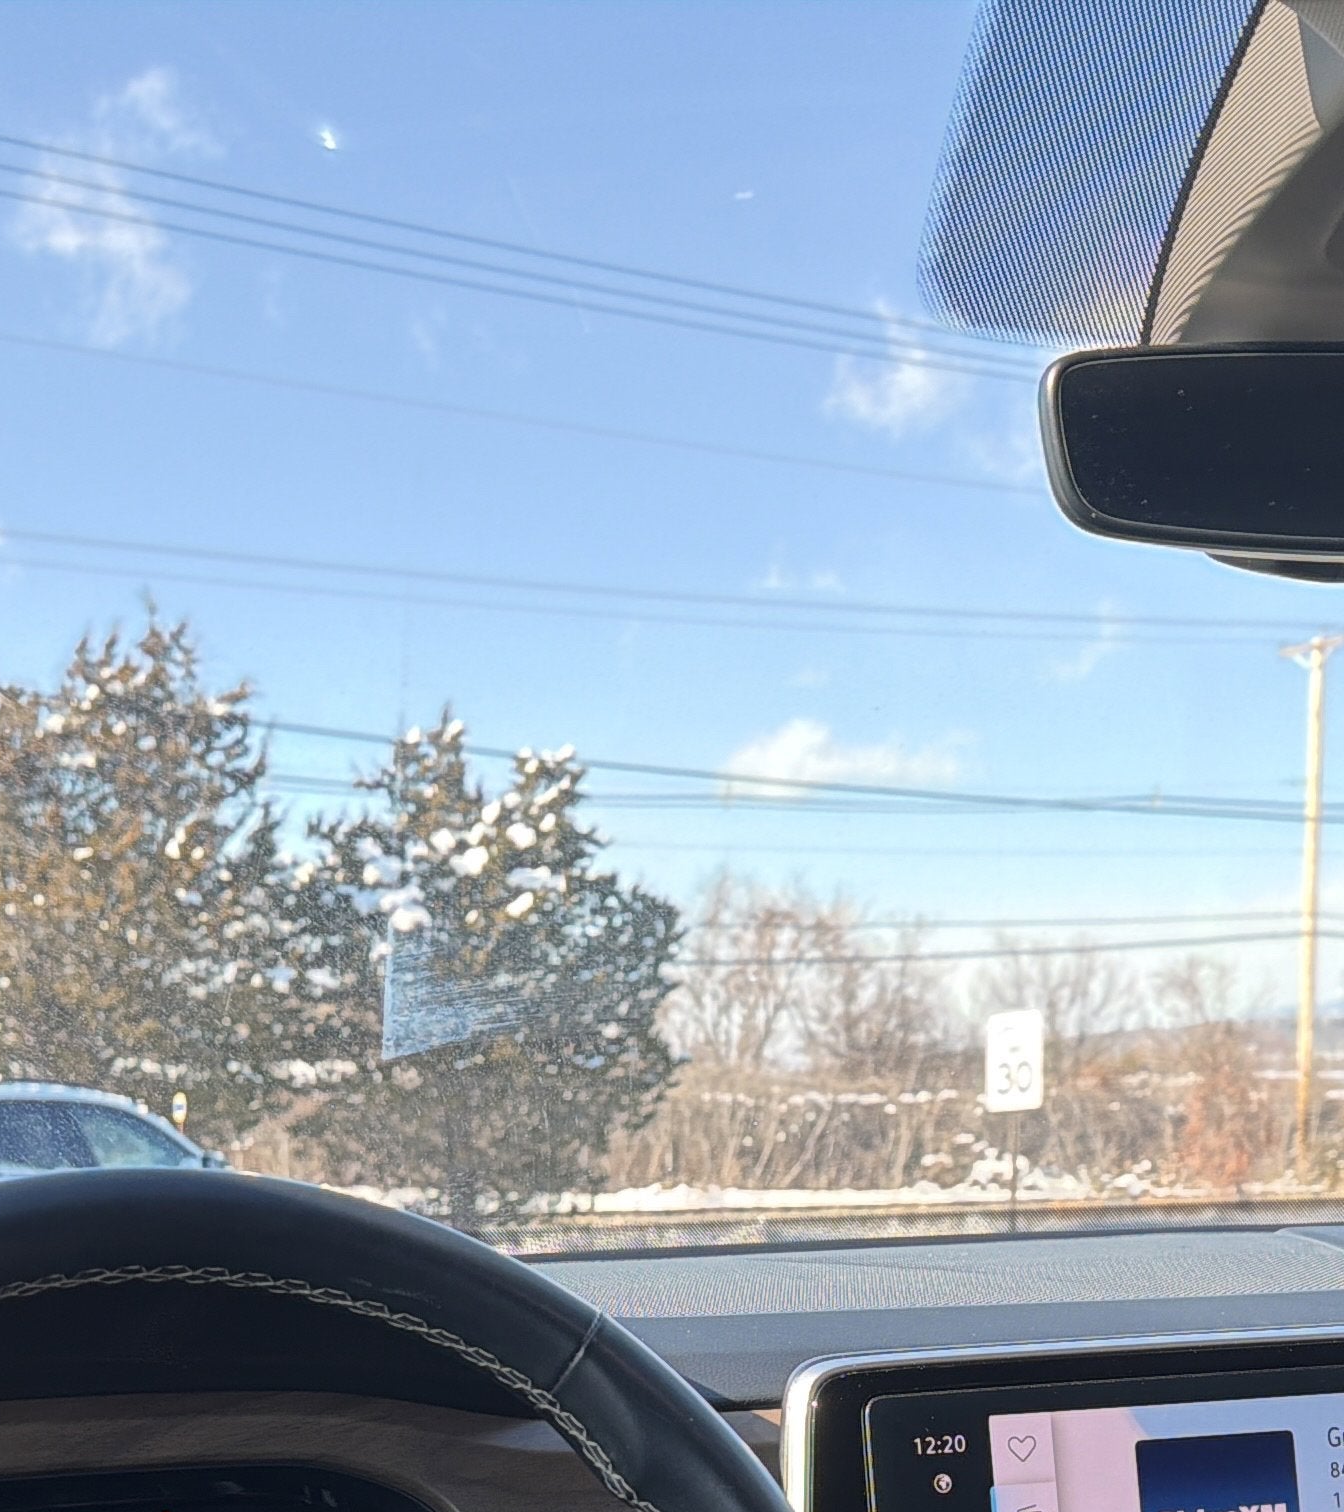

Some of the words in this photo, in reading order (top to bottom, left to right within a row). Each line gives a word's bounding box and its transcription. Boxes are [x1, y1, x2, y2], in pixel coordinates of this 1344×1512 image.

[997, 1060, 1033, 1095] 30
[913, 1434, 966, 1456] 12:20
[1334, 1492, 1342, 1508] 1
